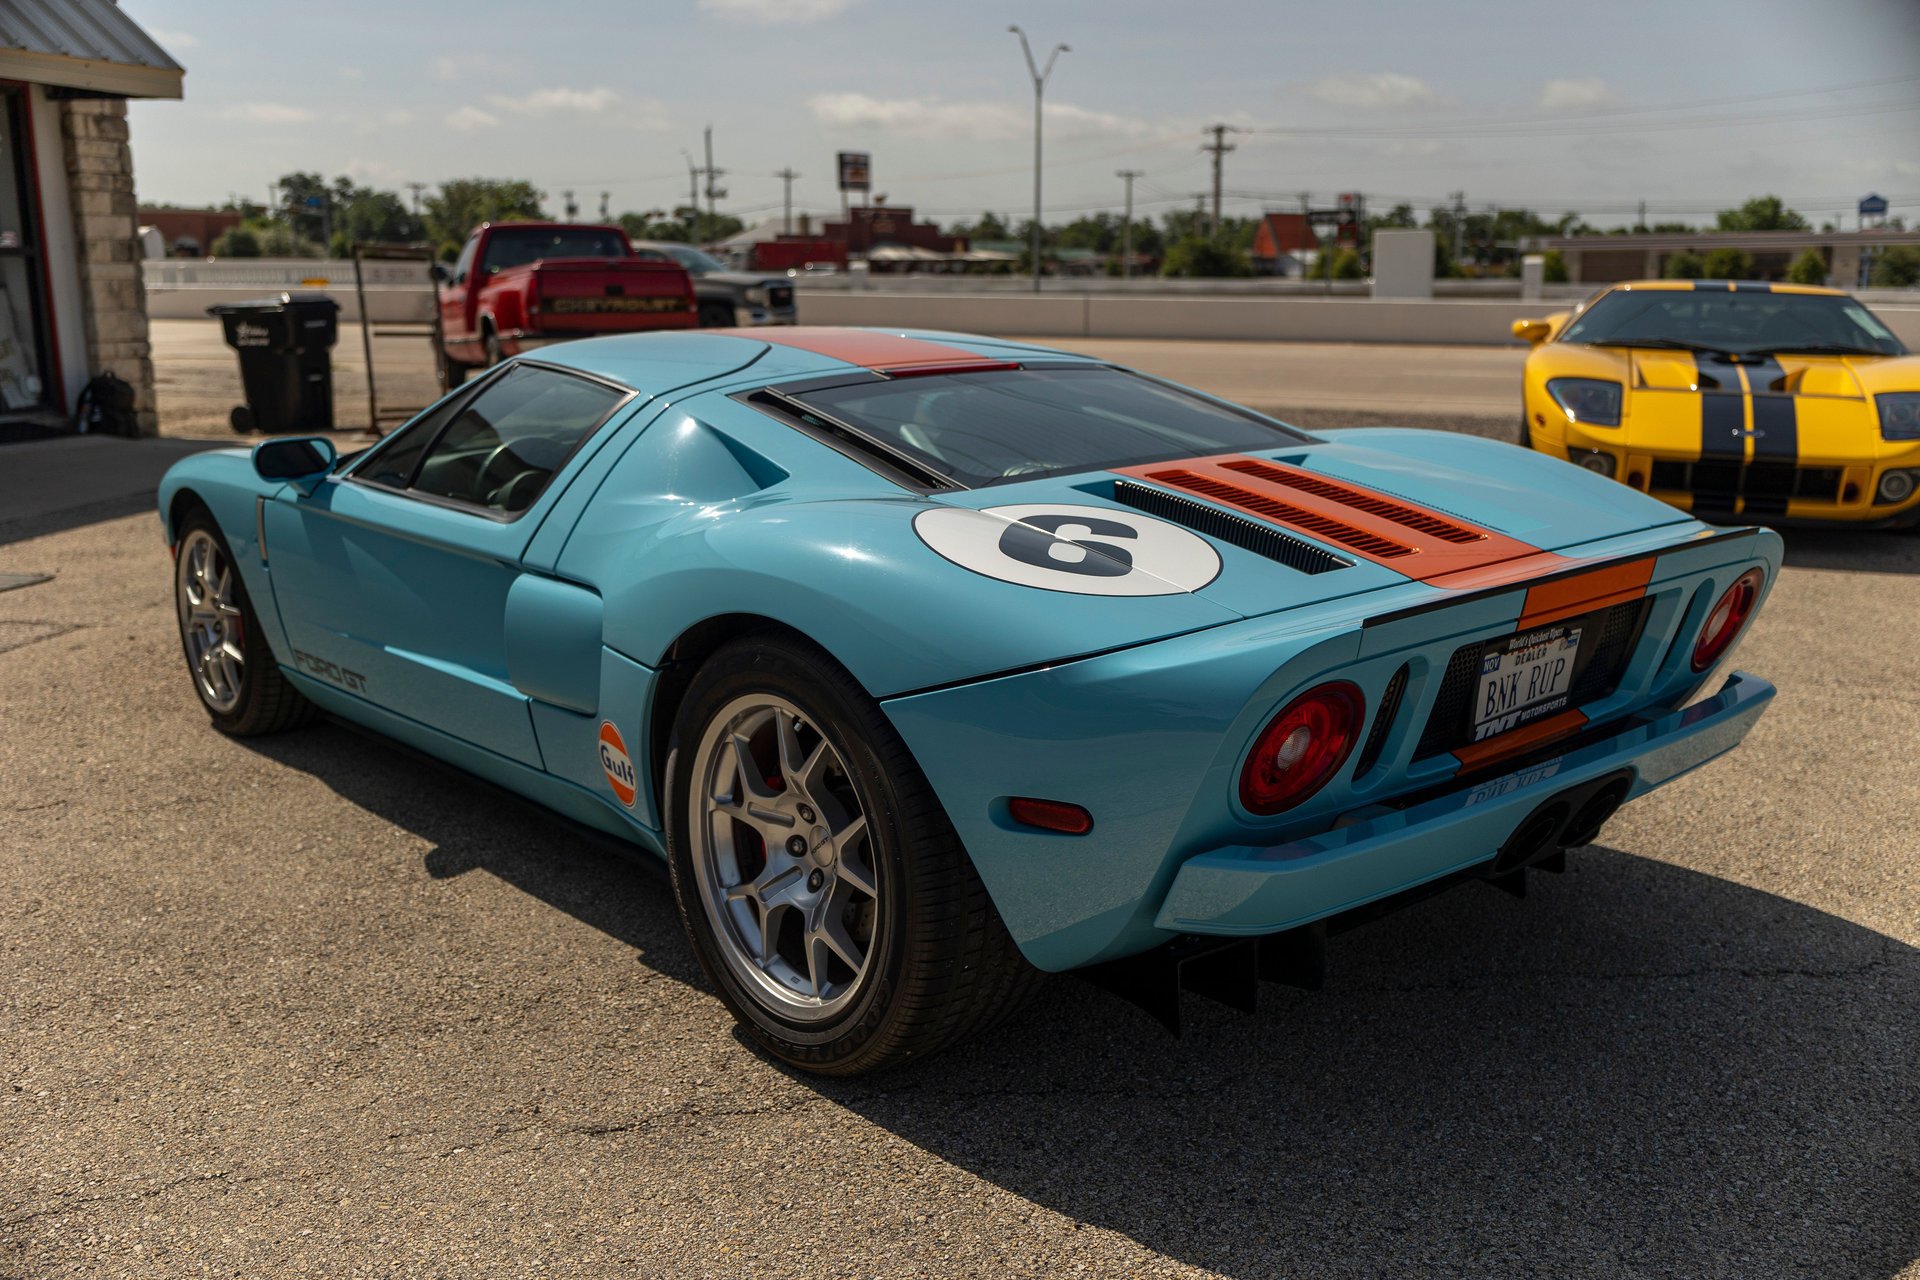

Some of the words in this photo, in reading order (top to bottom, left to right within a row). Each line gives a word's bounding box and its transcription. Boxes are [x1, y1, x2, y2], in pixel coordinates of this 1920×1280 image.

[999, 515, 1139, 578] 6
[294, 648, 342, 684] FORD
[341, 667, 367, 693] GT
[1483, 657, 1500, 673] NOV
[1514, 647, 1548, 667] DEALER
[1484, 670, 1523, 718] BNK
[1526, 657, 1566, 701] RUP
[1474, 710, 1522, 742] TNT
[1520, 696, 1568, 721] MOTORSPORTS
[600, 744, 634, 787] Gulf
